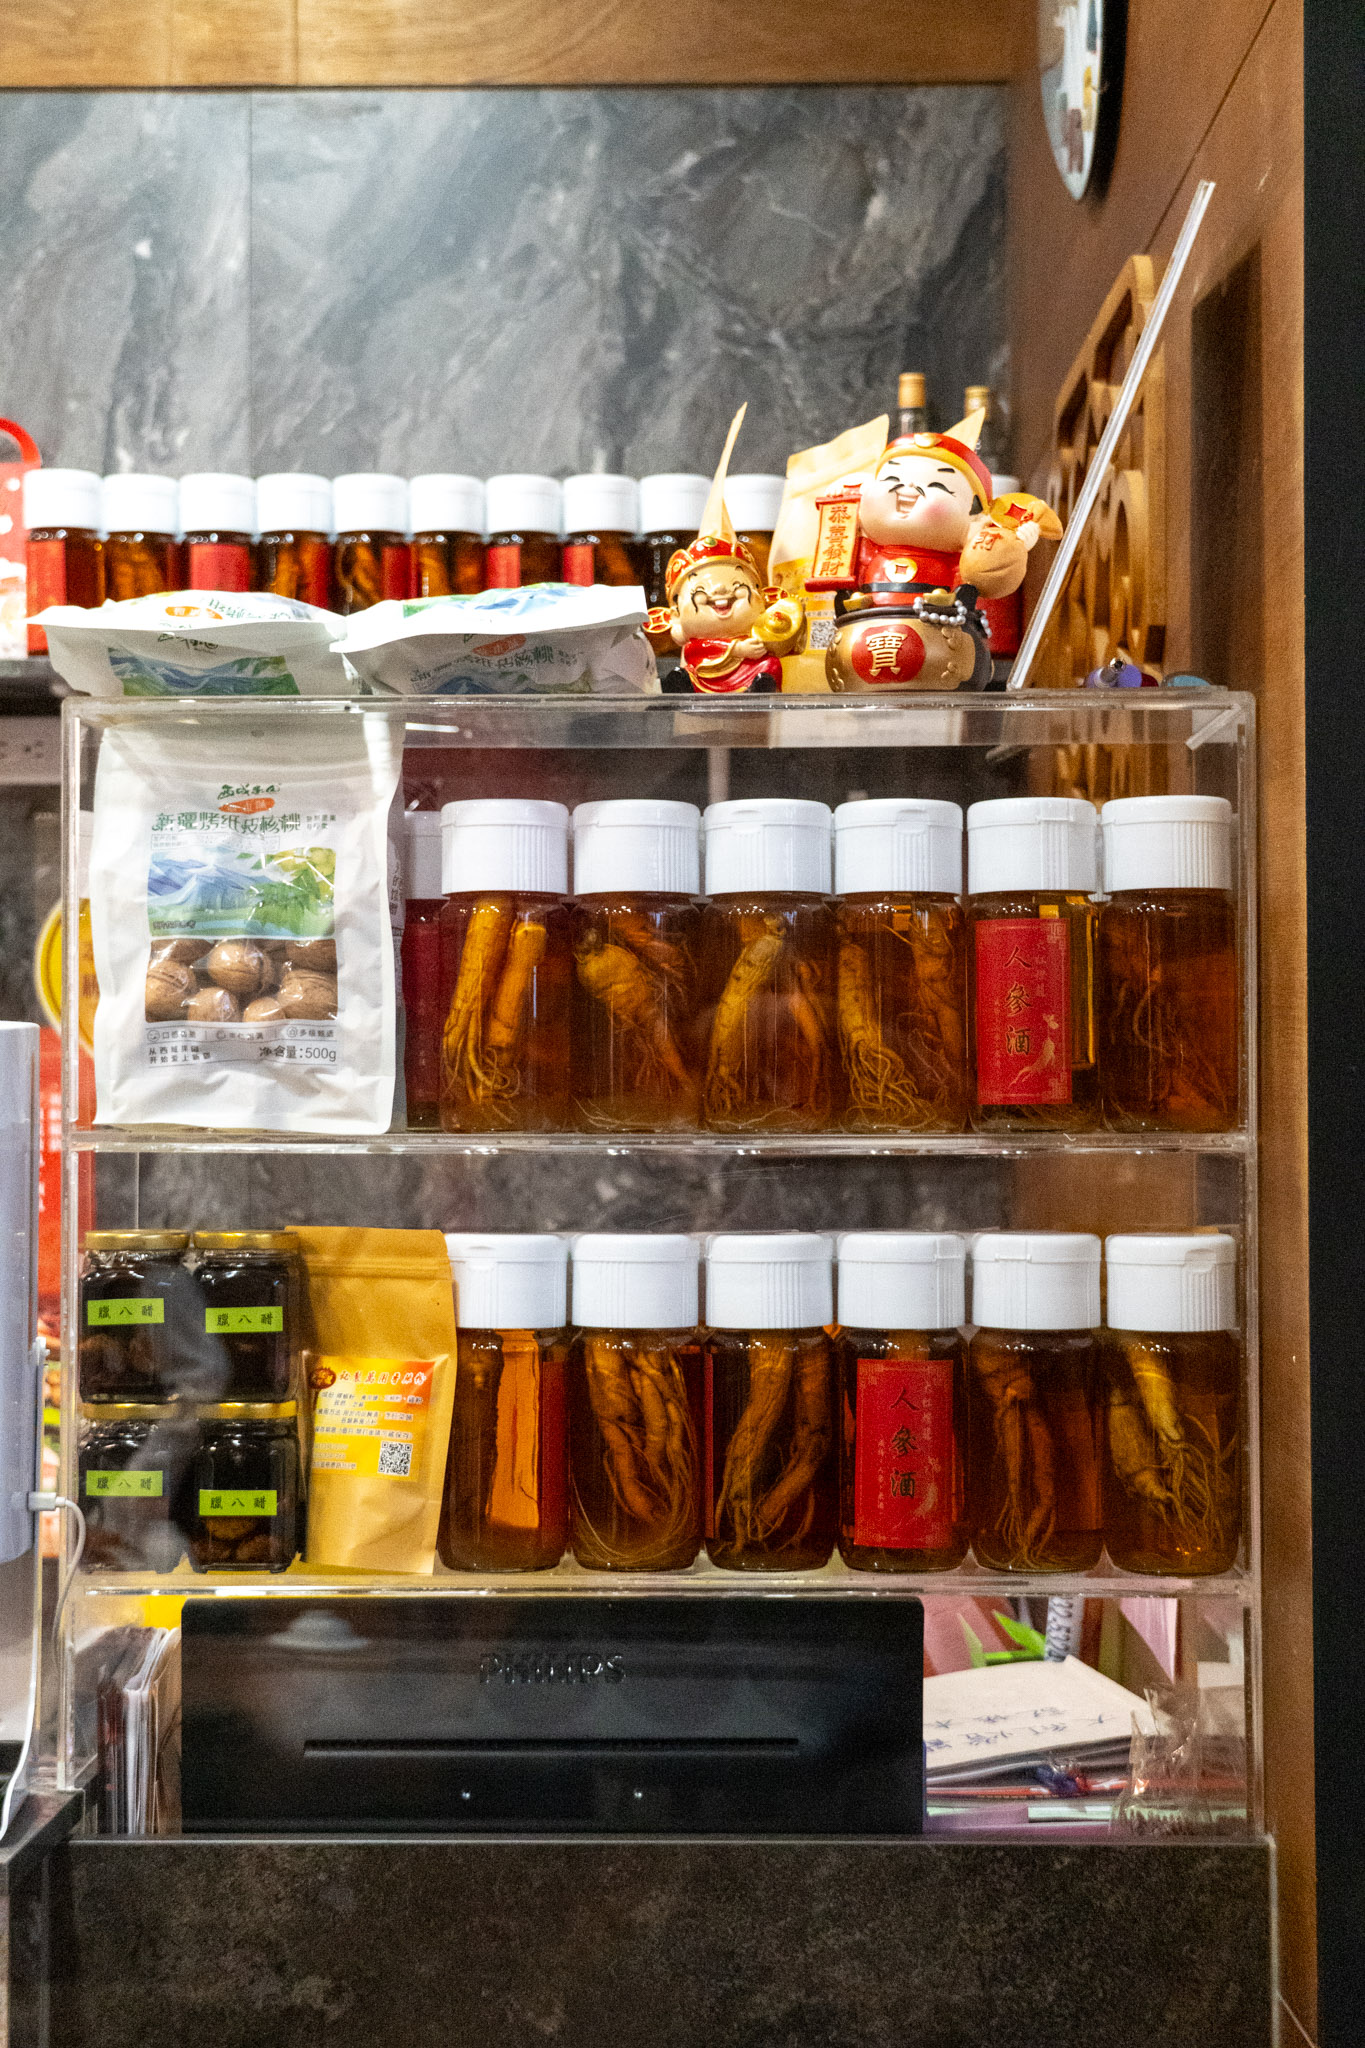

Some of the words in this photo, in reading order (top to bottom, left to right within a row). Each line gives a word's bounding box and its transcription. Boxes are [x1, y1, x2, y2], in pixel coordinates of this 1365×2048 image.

[818, 504, 852, 577] 恭喜發財
[972, 531, 1004, 551] 財
[865, 630, 908, 677] 寶
[151, 811, 301, 835] 新疆烤纸皮核桃
[479, 1652, 627, 1684] PHILIPS
